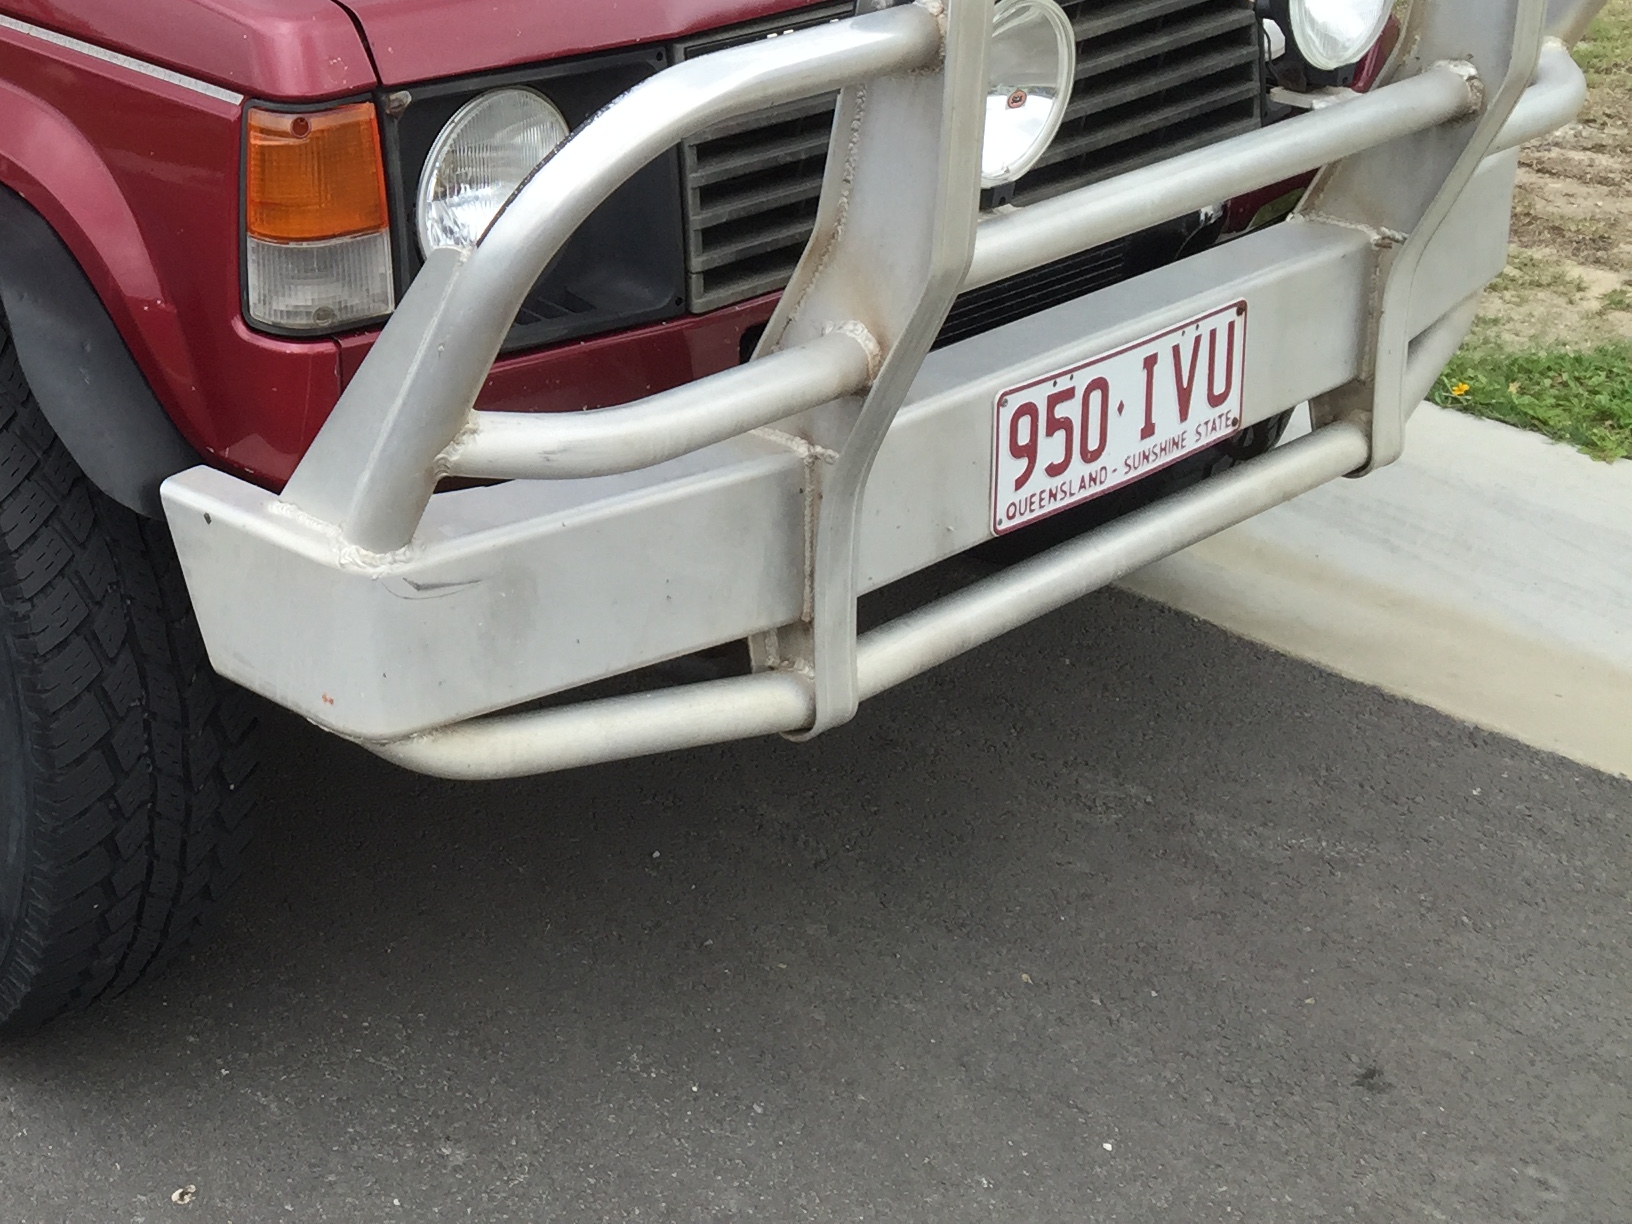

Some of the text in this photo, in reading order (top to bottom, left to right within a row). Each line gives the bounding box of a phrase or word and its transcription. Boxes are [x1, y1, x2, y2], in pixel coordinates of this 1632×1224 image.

[1005, 465, 1109, 521] QUEENSLAND
[1124, 430, 1188, 475] SUNSHINE
[1194, 409, 1233, 443] STATE
